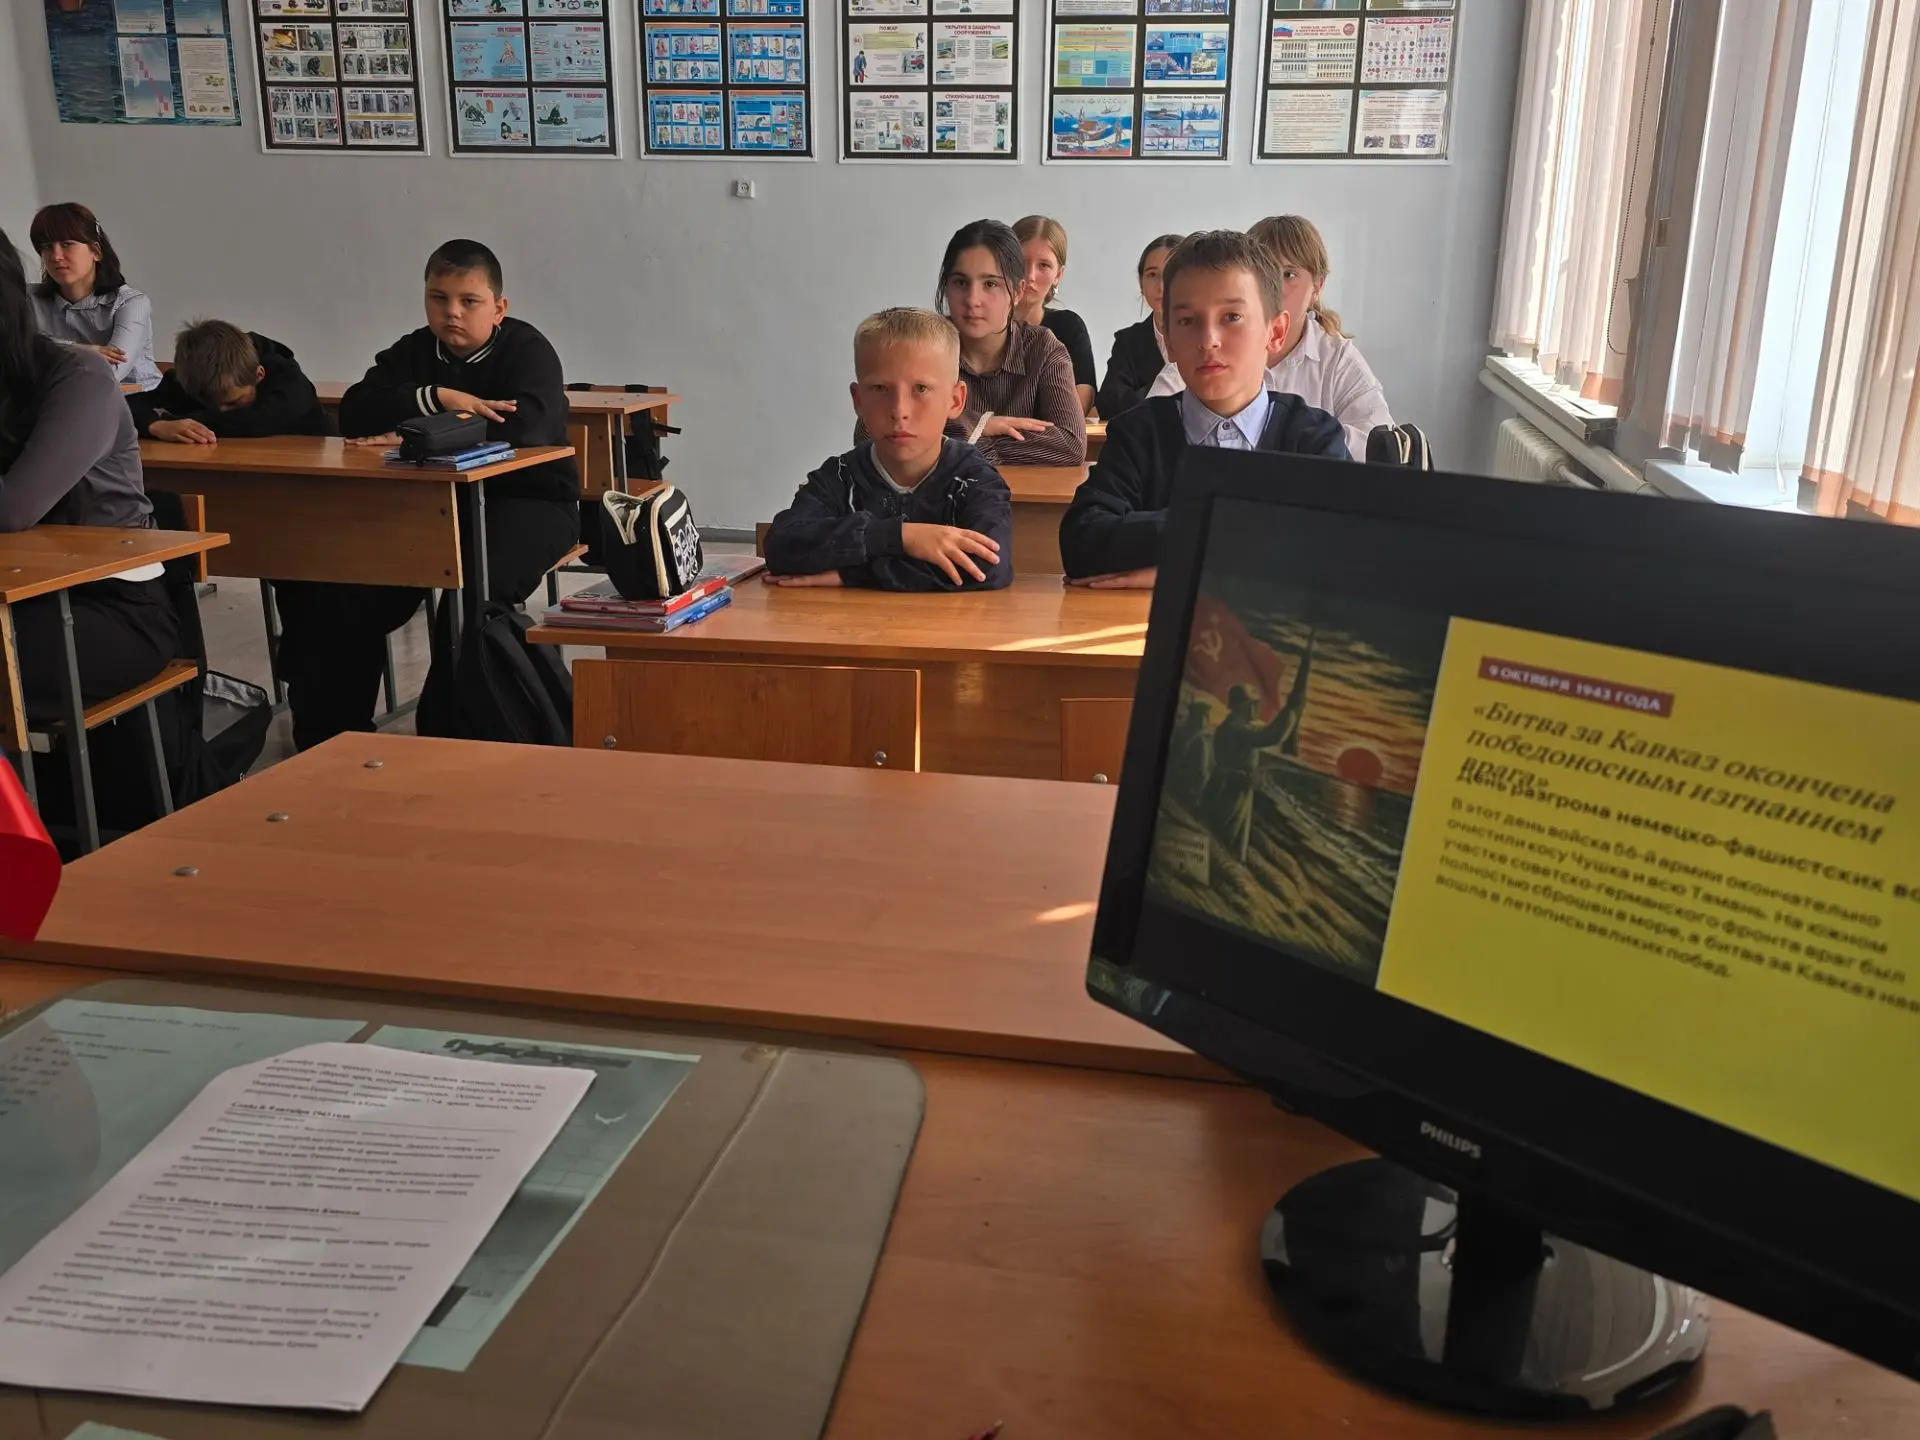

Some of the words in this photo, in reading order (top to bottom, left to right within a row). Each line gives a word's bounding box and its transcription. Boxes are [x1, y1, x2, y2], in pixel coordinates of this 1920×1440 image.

[1489, 665, 1498, 676] 9
[1500, 667, 1570, 692] ОКТЯБРЯ
[1576, 683, 1611, 699] 1943
[1614, 692, 1661, 711] ГОДА
[1460, 756, 1550, 789] врага»
[1466, 729, 1687, 799] победоносным
[1689, 783, 1885, 845] изгнанием
[1473, 701, 1568, 737] «Битва
[1570, 724, 1604, 745] за
[1608, 728, 1720, 772] Кавказ
[1723, 761, 1897, 814] окончена
[1447, 818, 1526, 849] очистили
[1528, 841, 1568, 863] косу
[1571, 851, 1630, 880] Чушка
[1633, 868, 1645, 883] и
[1647, 875, 1687, 897] всю
[1692, 884, 1767, 921] Тамань.
[1773, 910, 1804, 931] На
[1806, 922, 1888, 955] южном
[1451, 797, 1462, 811] В
[1466, 803, 1501, 821] этот
[1503, 813, 1545, 834] день
[1547, 824, 1611, 853] войска
[1613, 841, 1657, 865] 56-й
[1658, 859, 1723, 883] армии
[1726, 875, 1882, 929] окончательно
[1456, 768, 1507, 792] День
[1511, 779, 1611, 820] разгрома
[1617, 811, 1884, 892] немецко-фашистских
[1436, 873, 1488, 900] вошла
[1490, 892, 1501, 904] в
[1502, 896, 1585, 931] летопись
[1586, 921, 1663, 955] великих
[1665, 948, 1731, 979] побед.
[1439, 855, 1530, 892] полностью
[1531, 883, 1613, 917] сброшен
[1615, 909, 1627, 922] в
[1629, 913, 1685, 943] море,
[1687, 932, 1700, 945] а
[1704, 934, 1765, 965] битва
[1767, 956, 1793, 974] за
[1796, 962, 1876, 1001] Кавказ
[1444, 838, 1508, 866] участке
[1510, 856, 1720, 929] советско-германского
[1722, 919, 1802, 954] фронта
[1804, 944, 1856, 971] враг
[1859, 957, 1906, 985] был
[1420, 1121, 1481, 1159] PHILIPS
